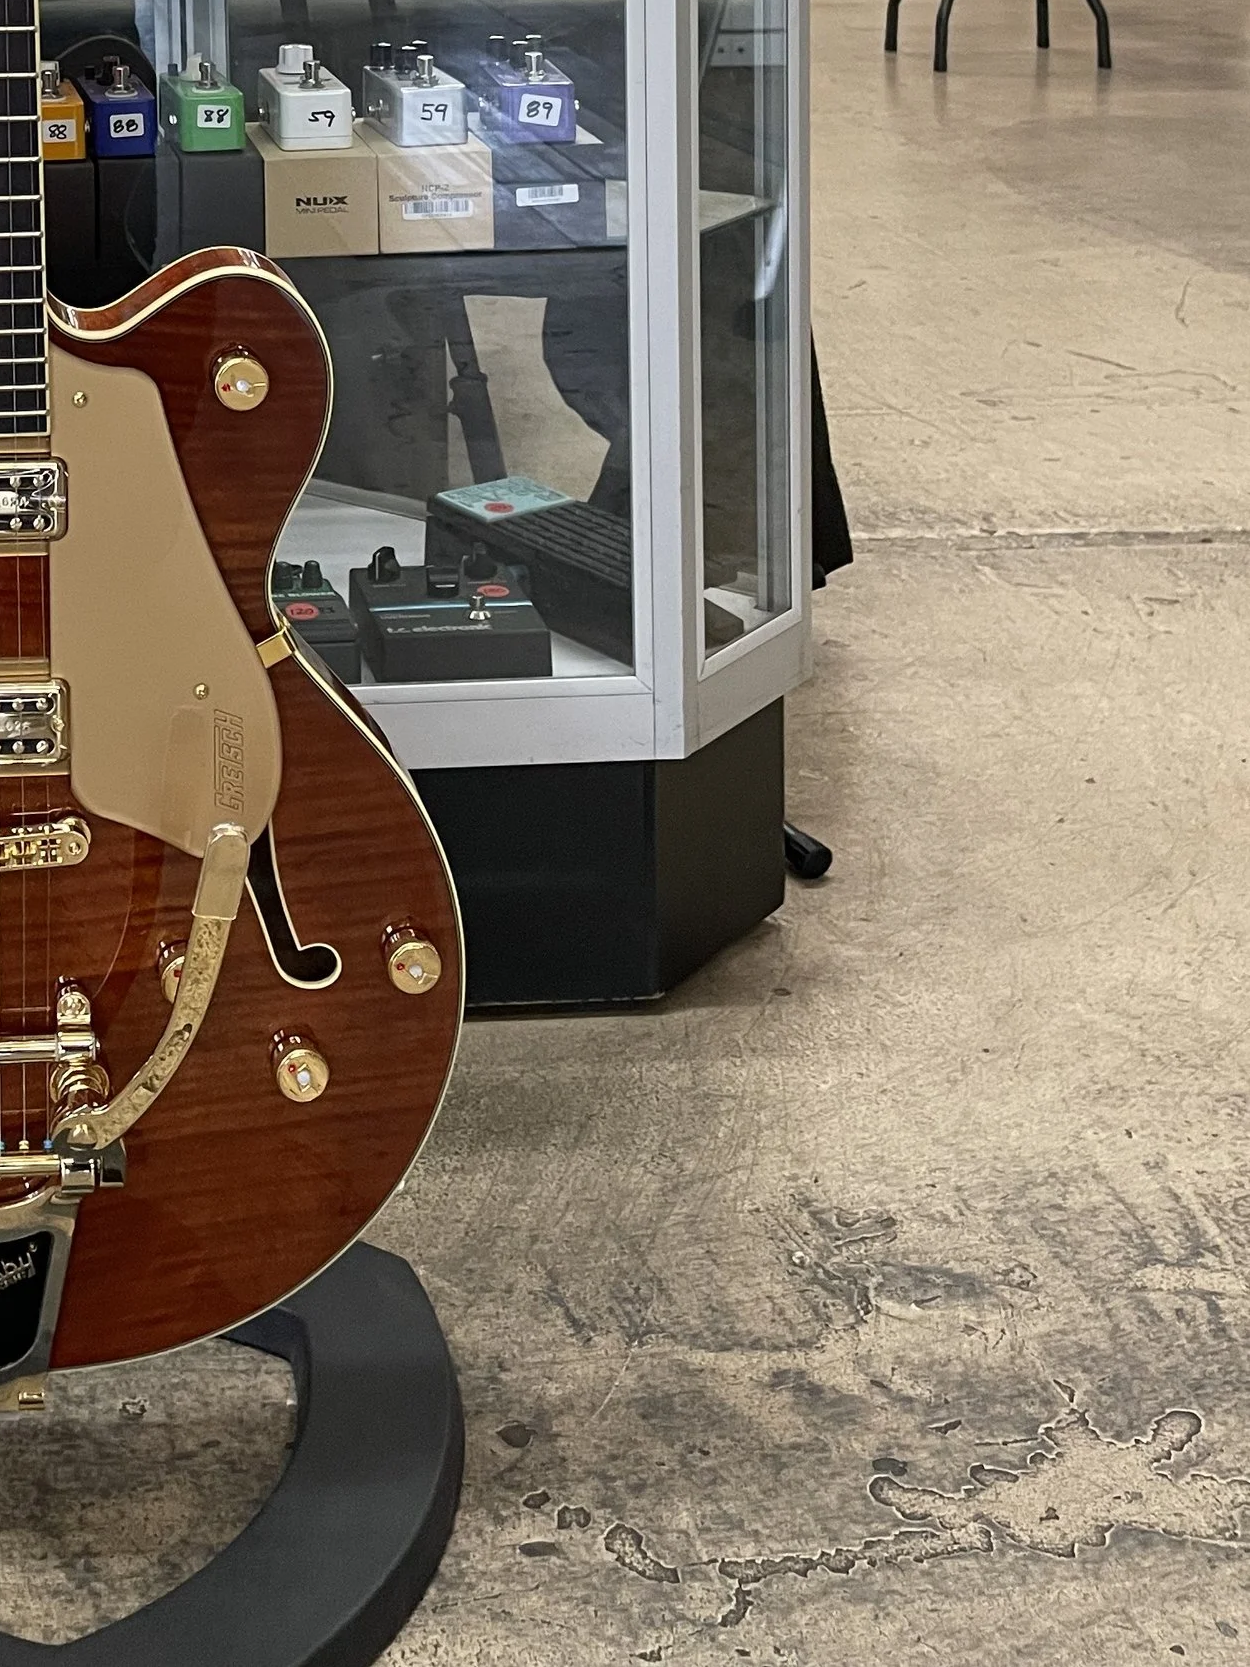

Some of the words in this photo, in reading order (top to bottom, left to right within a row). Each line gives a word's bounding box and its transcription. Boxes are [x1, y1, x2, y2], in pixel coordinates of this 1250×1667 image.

[308, 110, 336, 127] 59
[420, 103, 448, 121] 59
[526, 100, 553, 120] 89
[295, 195, 349, 207] NUX
[213, 708, 245, 815] GRETSCH
